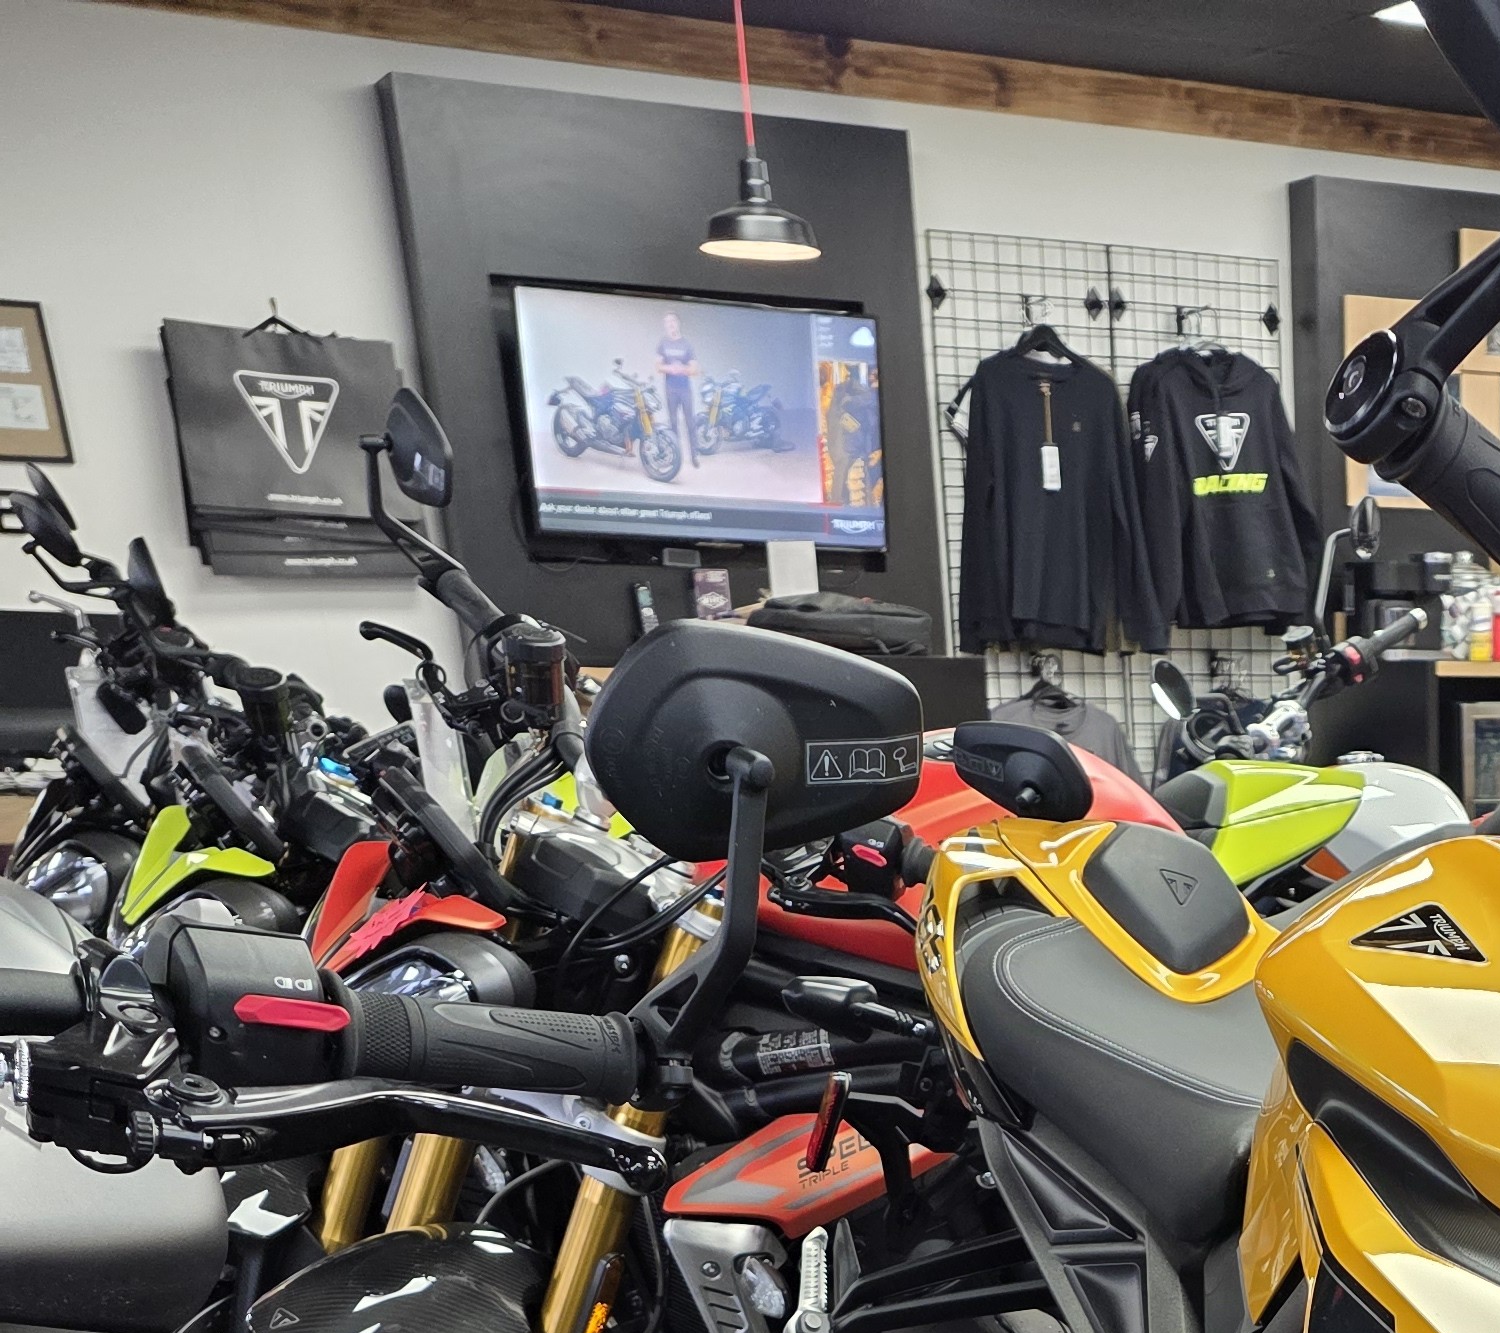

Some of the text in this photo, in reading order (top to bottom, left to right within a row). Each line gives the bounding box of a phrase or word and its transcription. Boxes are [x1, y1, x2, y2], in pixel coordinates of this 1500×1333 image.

[258, 380, 315, 398] TRIUMPH
[1430, 913, 1471, 951] TRIUMPH
[798, 1160, 850, 1190] TRIPLE
